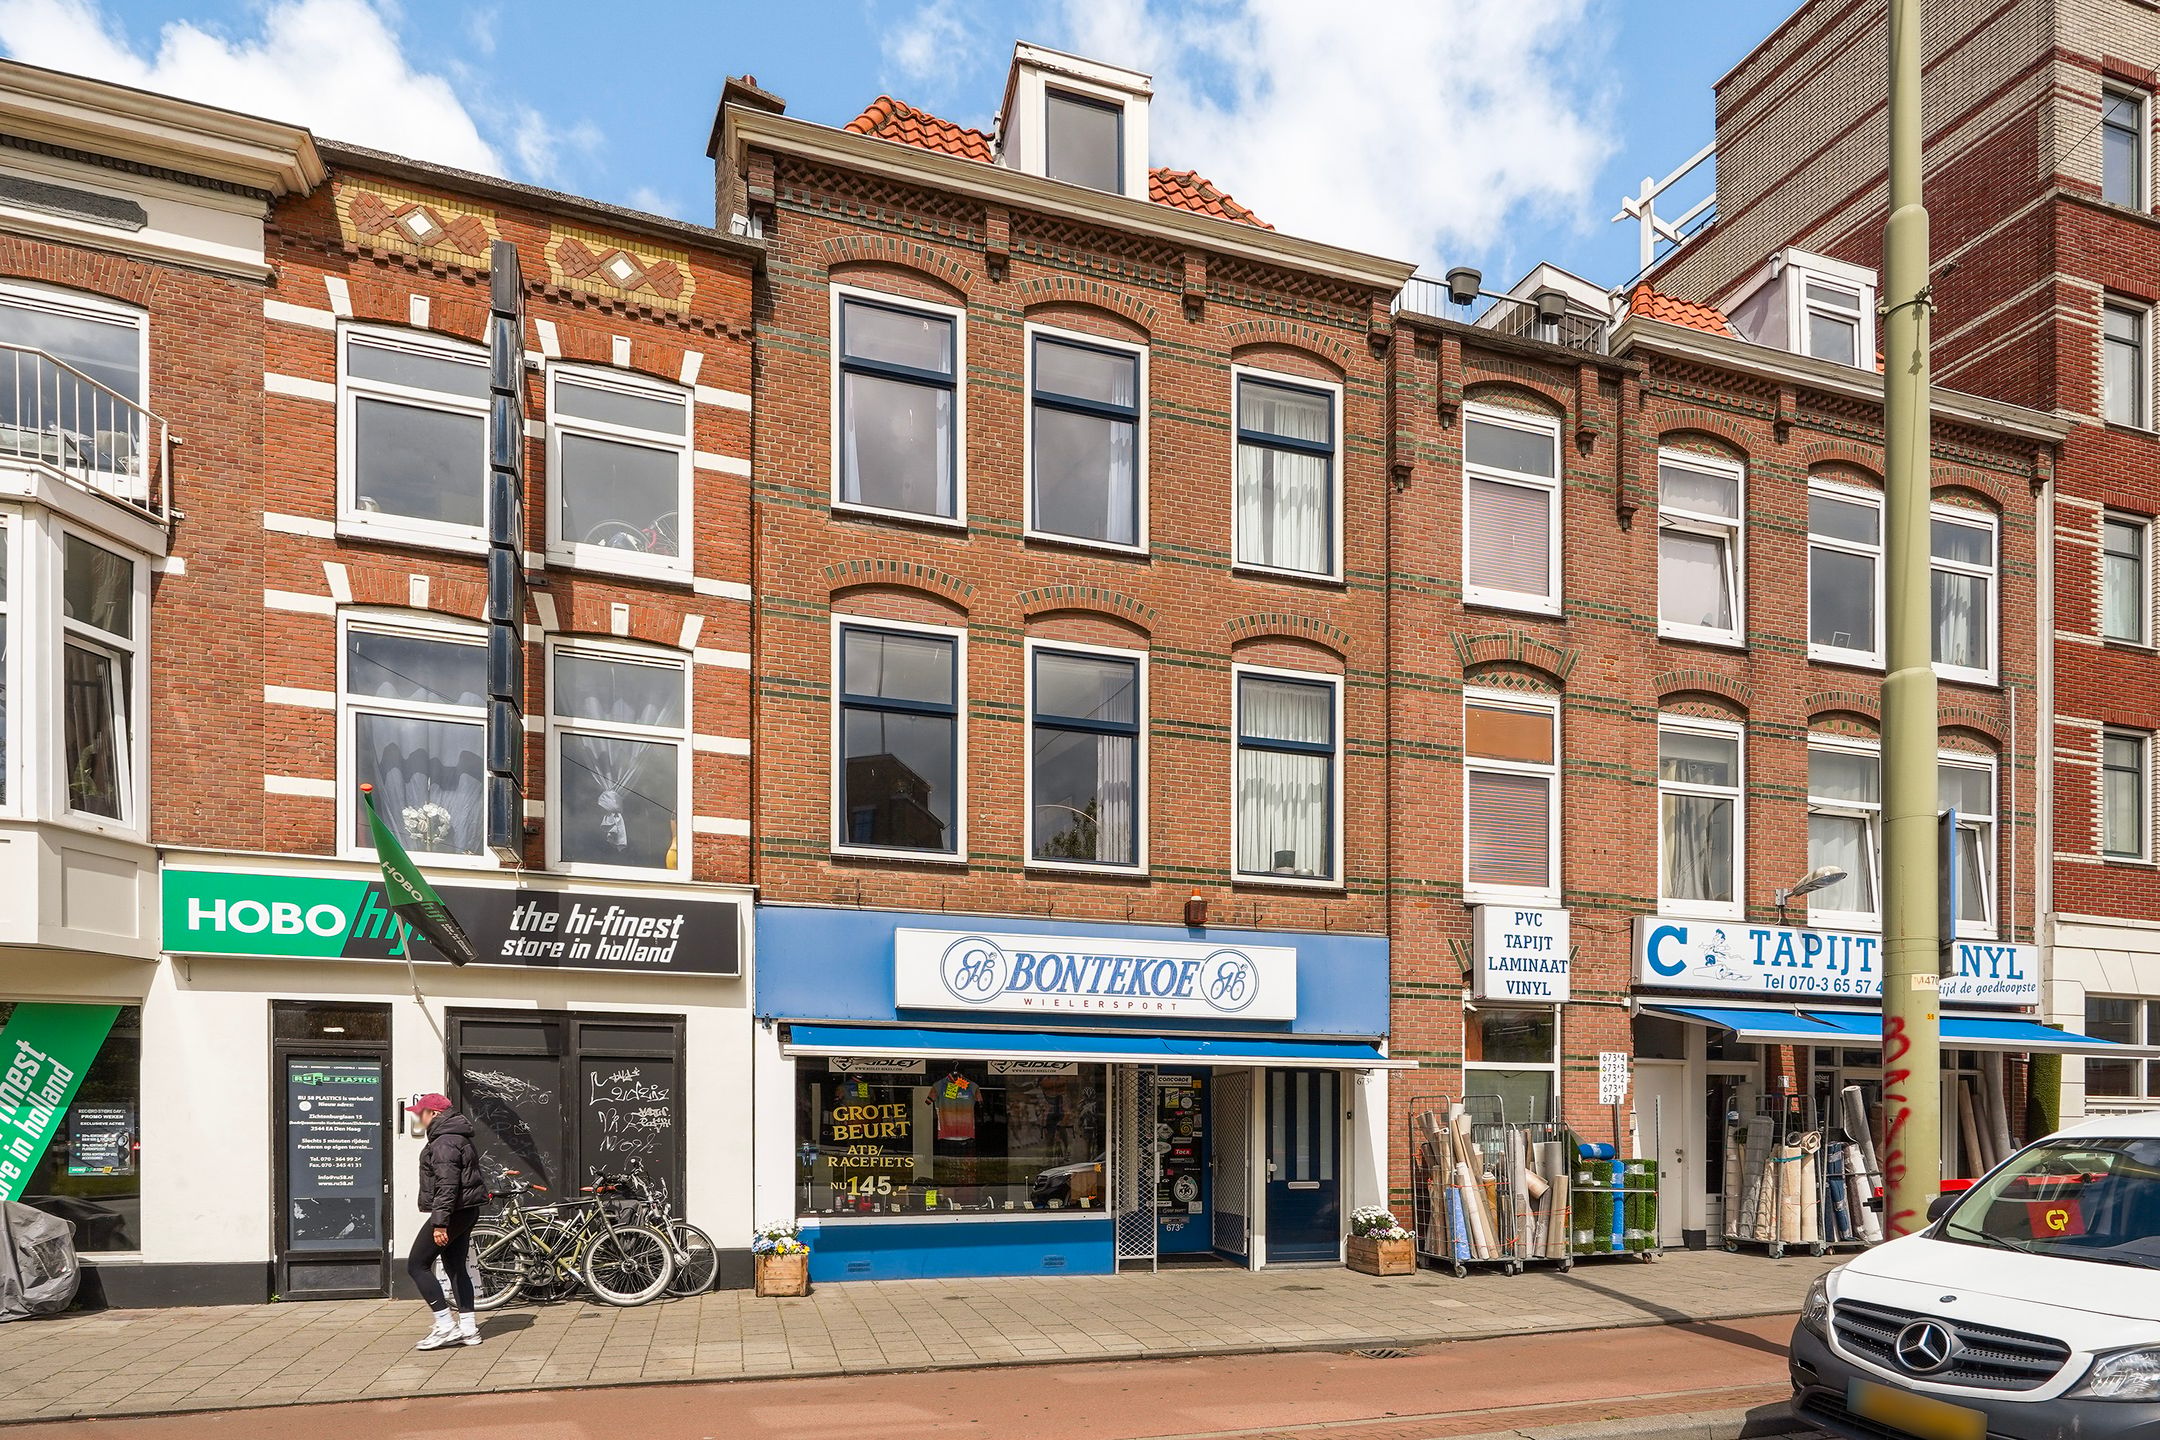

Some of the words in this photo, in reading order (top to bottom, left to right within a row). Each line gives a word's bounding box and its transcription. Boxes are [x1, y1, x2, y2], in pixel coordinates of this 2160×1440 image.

[381, 860, 423, 901] HOBO
[188, 897, 347, 937] HOBO
[510, 901, 560, 932] the
[565, 903, 684, 939] hi-finest
[1515, 911, 1543, 927] PVC
[501, 936, 565, 958] store
[568, 938, 592, 959] in
[595, 937, 678, 963] holland
[1503, 934, 1553, 952] TAPIJT
[1647, 925, 1688, 977] C
[1749, 929, 1876, 976] TAPIJT
[1959, 944, 2024, 980] NYL
[1488, 956, 1568, 974] LAMINAAT
[1005, 952, 1202, 998] BONTEKOE
[1763, 974, 1785, 989] Tel
[1789, 975, 1829, 992] 070-3
[1833, 978, 1850, 993] 65
[1855, 979, 1872, 994] 57
[1506, 980, 1552, 996] VINYL
[1960, 981, 1972, 994] de
[1975, 980, 2036, 997] goedkoopste
[1024, 998, 1178, 1010] WIELERSPORT
[12, 1056, 75, 1139] holland
[832, 1103, 907, 1122] GROTE
[832, 1121, 911, 1141] BEURT
[3, 1137, 35, 1163] in
[847, 1145, 884, 1157] ATB/
[827, 1156, 915, 1168] RACEFIETS
[830, 1181, 848, 1190] NU
